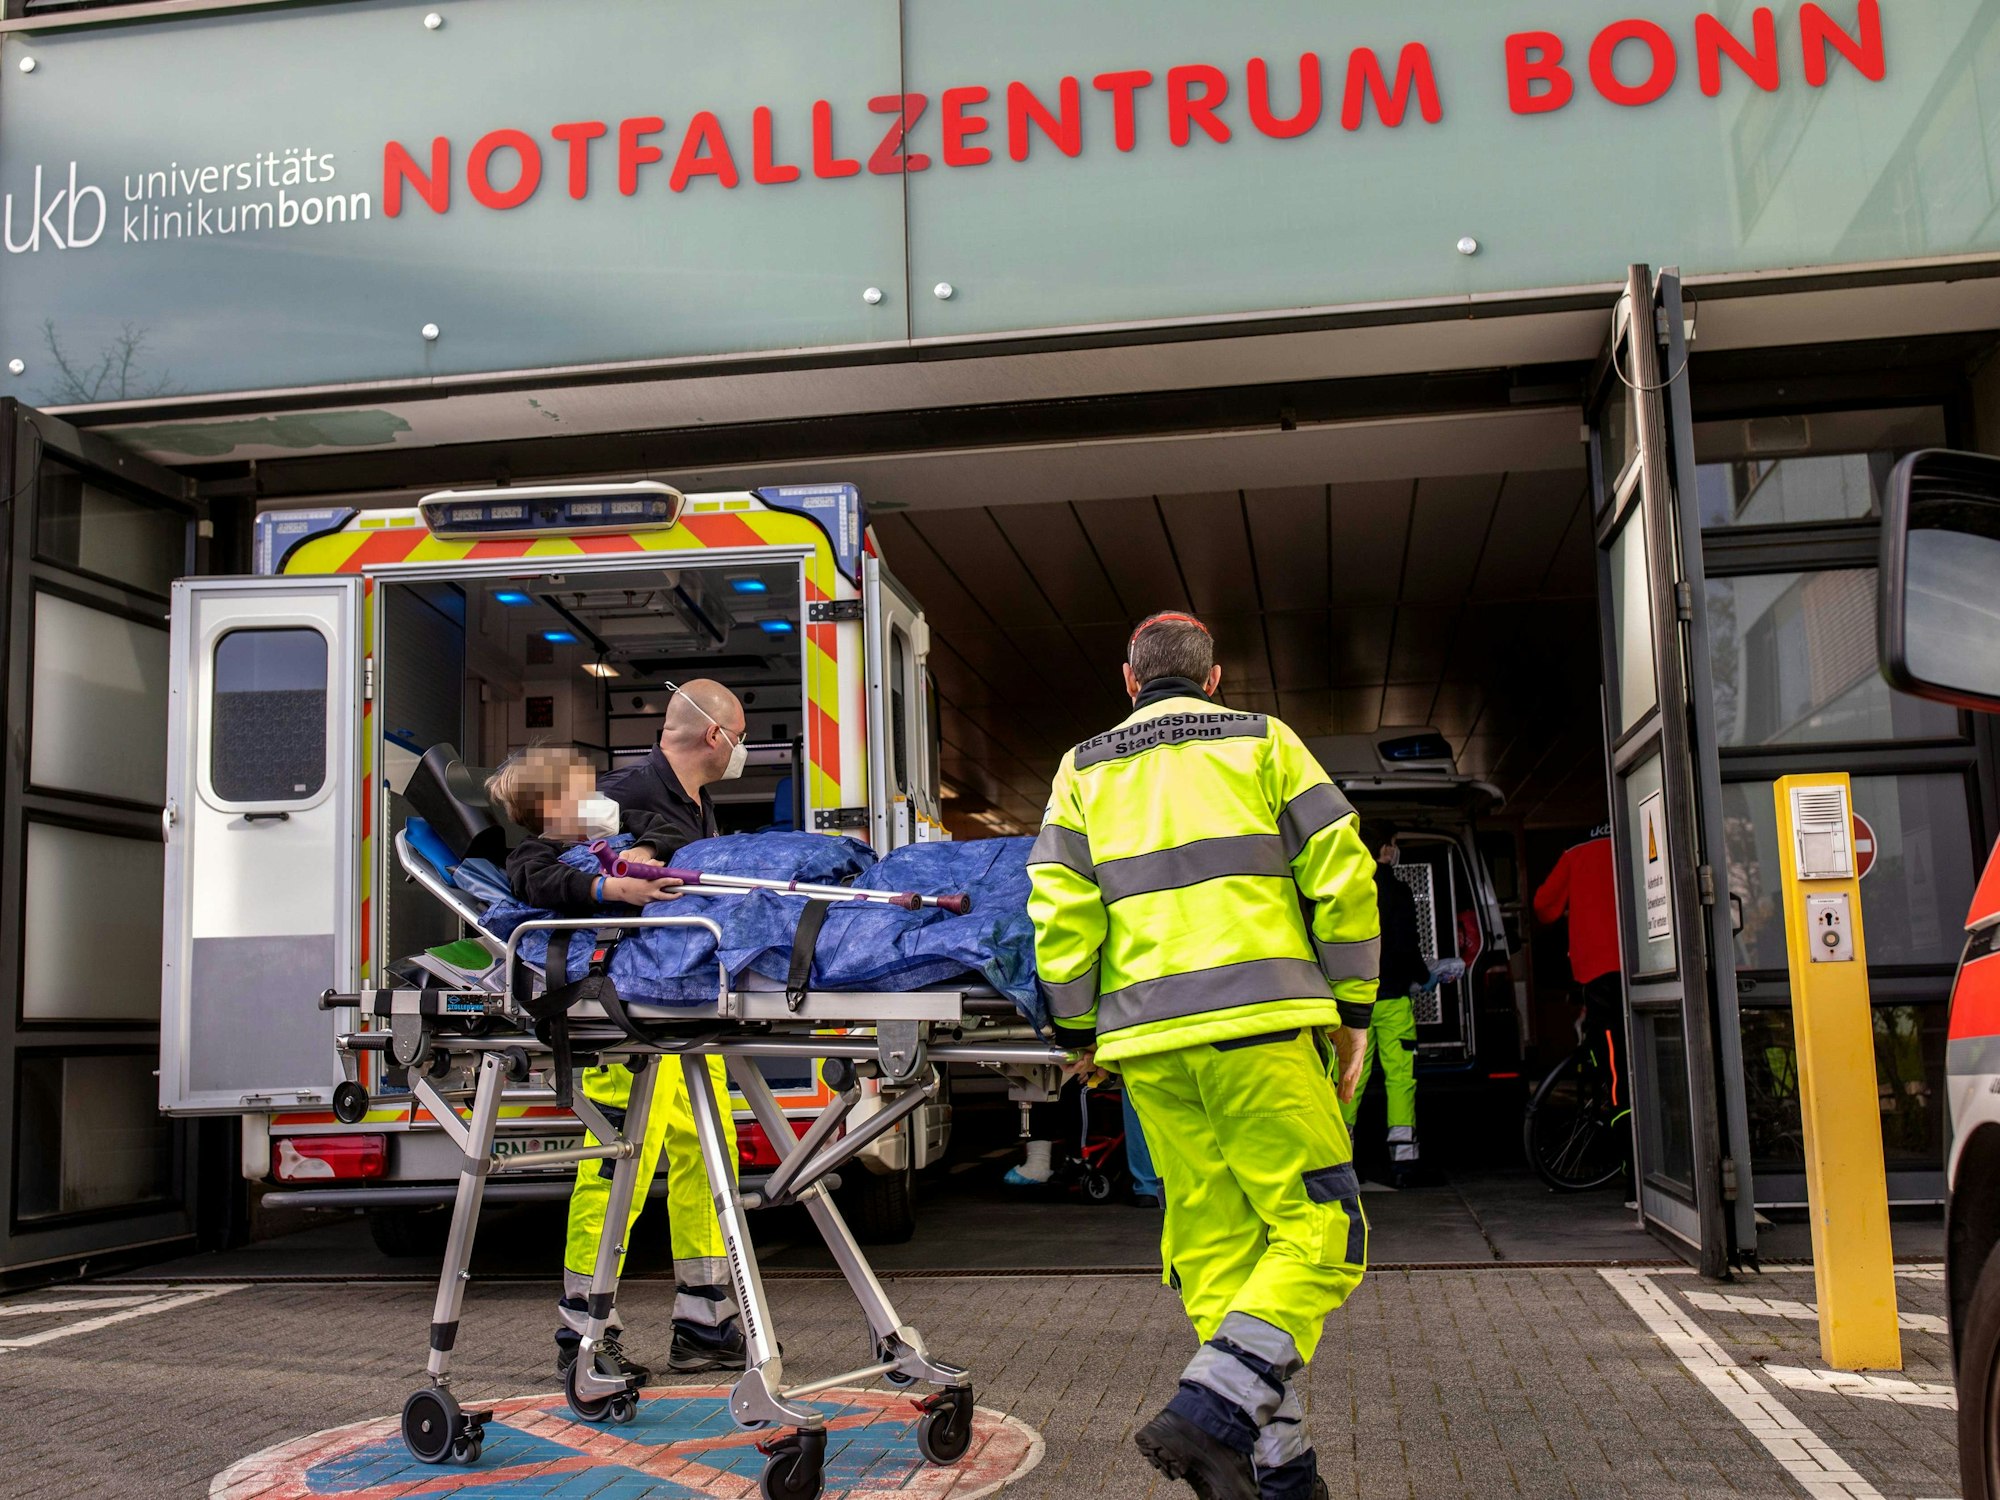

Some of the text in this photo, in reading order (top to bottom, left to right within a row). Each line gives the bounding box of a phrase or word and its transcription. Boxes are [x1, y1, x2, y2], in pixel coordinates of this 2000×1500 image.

[382, 0, 1886, 218] NOTFALLZENTRUM BONN
[123, 147, 336, 202] universitäts
[3, 160, 107, 254] ukb
[123, 189, 372, 243] klinikumbonn
[1078, 713, 1263, 755] RETTUNGSDIENST
[1115, 726, 1222, 755] Stadt Bonn
